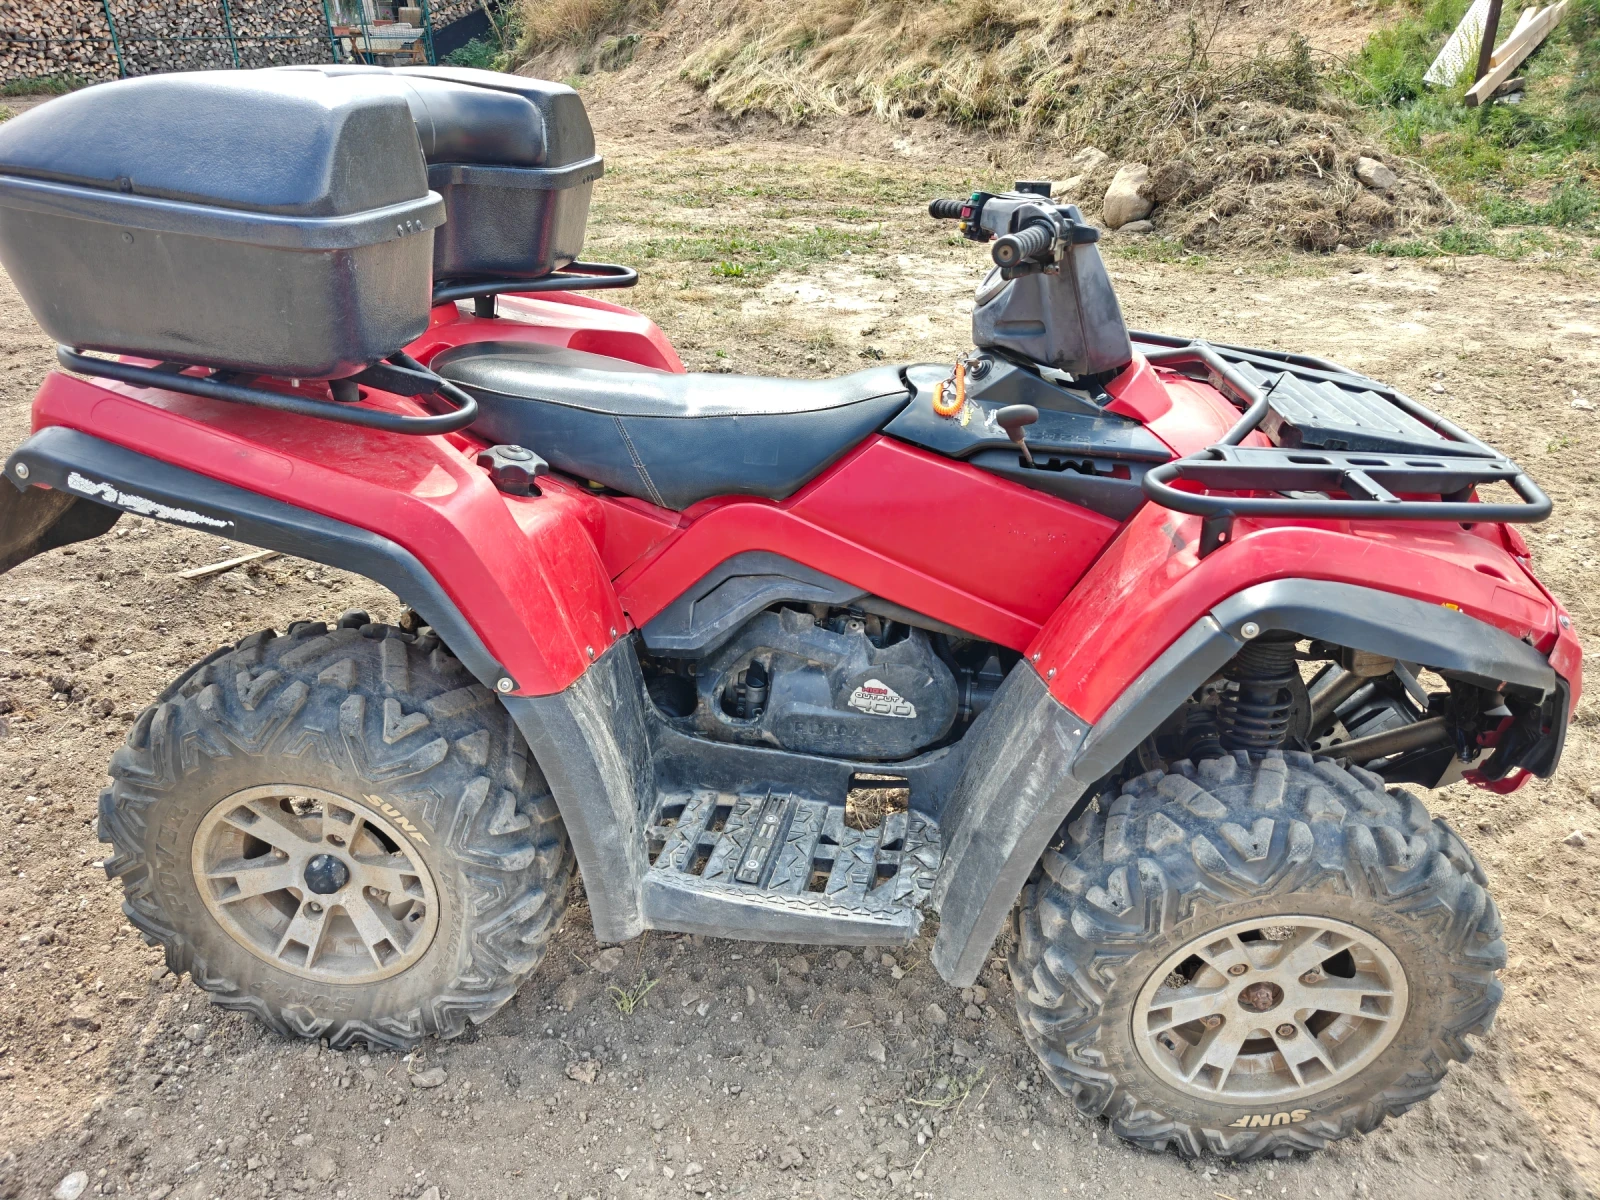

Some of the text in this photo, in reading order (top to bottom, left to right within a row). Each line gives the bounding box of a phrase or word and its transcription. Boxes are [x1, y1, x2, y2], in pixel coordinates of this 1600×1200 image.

[854, 691, 900, 703] OUTPUT
[861, 686, 888, 695] HIGH
[854, 697, 912, 716] 400
[361, 793, 431, 847] SUNF
[1227, 1108, 1312, 1128] SUNF
